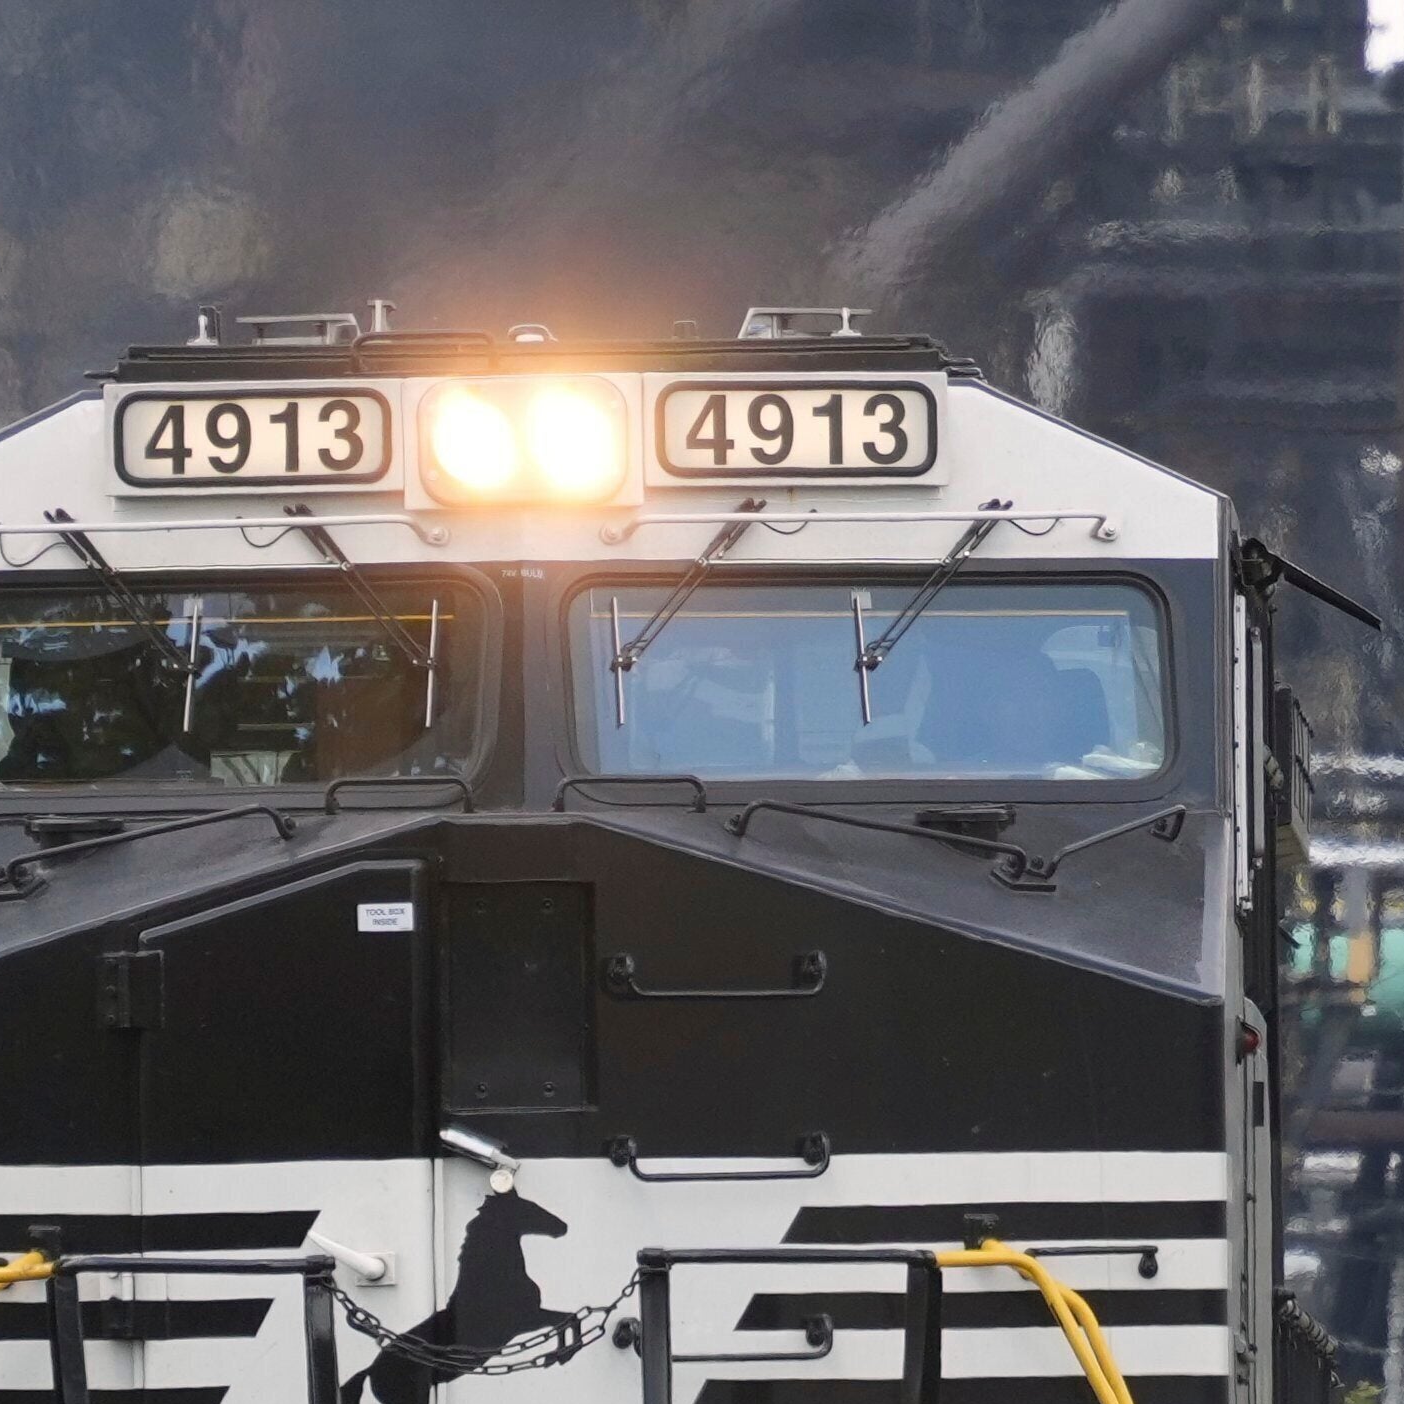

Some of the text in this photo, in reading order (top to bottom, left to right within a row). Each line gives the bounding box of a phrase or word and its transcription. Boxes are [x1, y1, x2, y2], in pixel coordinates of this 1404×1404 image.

[145, 400, 364, 474] 4913
[686, 394, 908, 465] 4913
[365, 907, 405, 916] TOOL BOX
[372, 917, 398, 926] INSIDE
